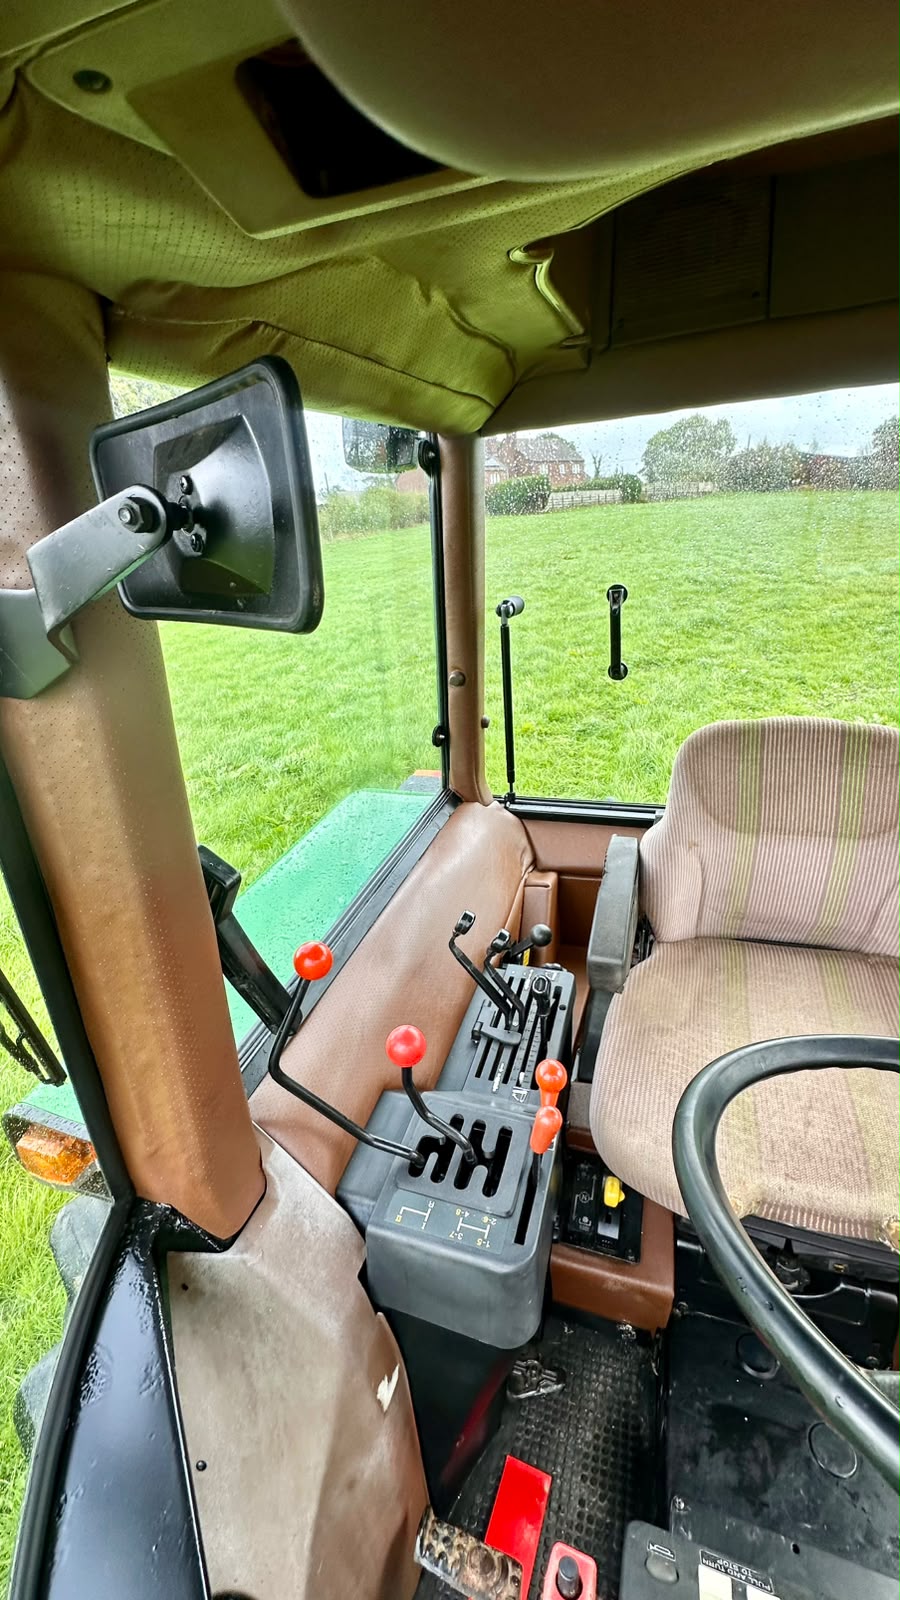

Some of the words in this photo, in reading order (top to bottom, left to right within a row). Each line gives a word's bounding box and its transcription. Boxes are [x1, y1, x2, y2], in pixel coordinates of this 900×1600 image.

[428, 1201, 436, 1209] R
[455, 1208, 470, 1218] 4-8
[482, 1216, 498, 1226] 2-6
[449, 1231, 464, 1240] 3-7
[476, 1238, 491, 1248] 1-5
[703, 1558, 726, 1572] TURN
[717, 1559, 739, 1571] STOP
[727, 1568, 746, 1581] AND
[741, 1568, 752, 1577] TO
[748, 1577, 771, 1591] PULL
